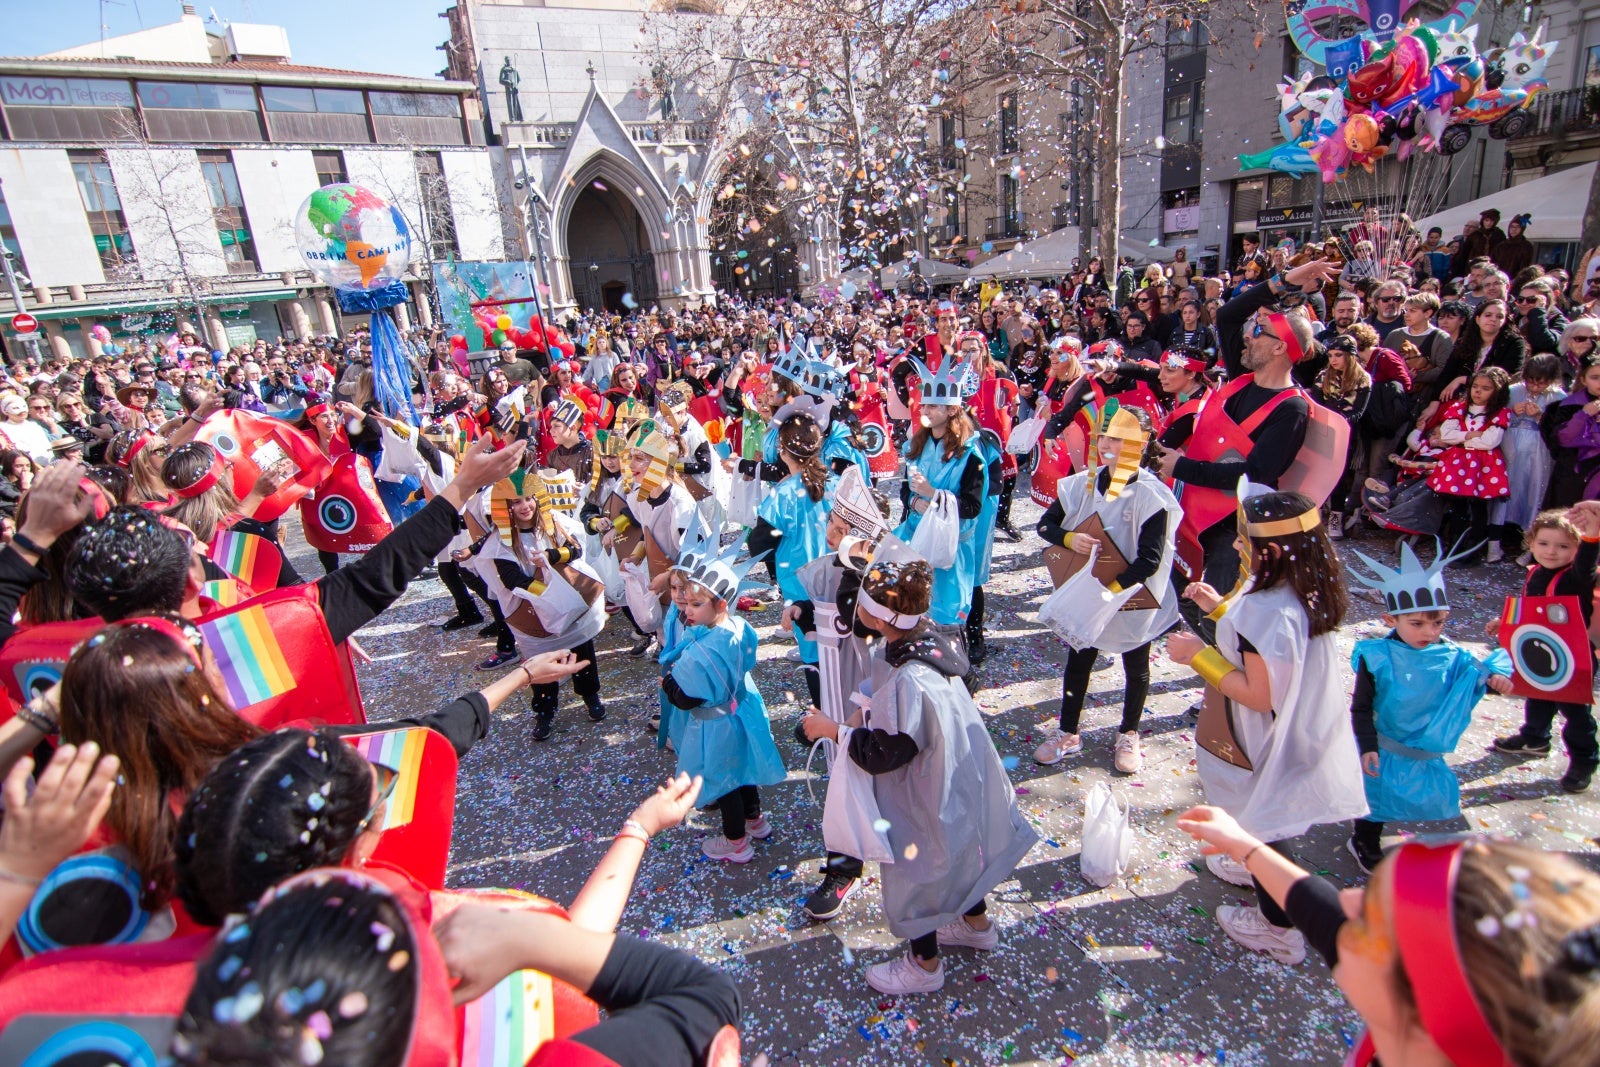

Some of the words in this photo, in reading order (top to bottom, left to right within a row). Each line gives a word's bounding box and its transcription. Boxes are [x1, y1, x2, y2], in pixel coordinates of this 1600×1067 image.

[1260, 214, 1285, 223] Marco
[1326, 207, 1354, 217] Marco
[306, 251, 348, 261] OBRIM
[348, 543, 378, 551] sales
